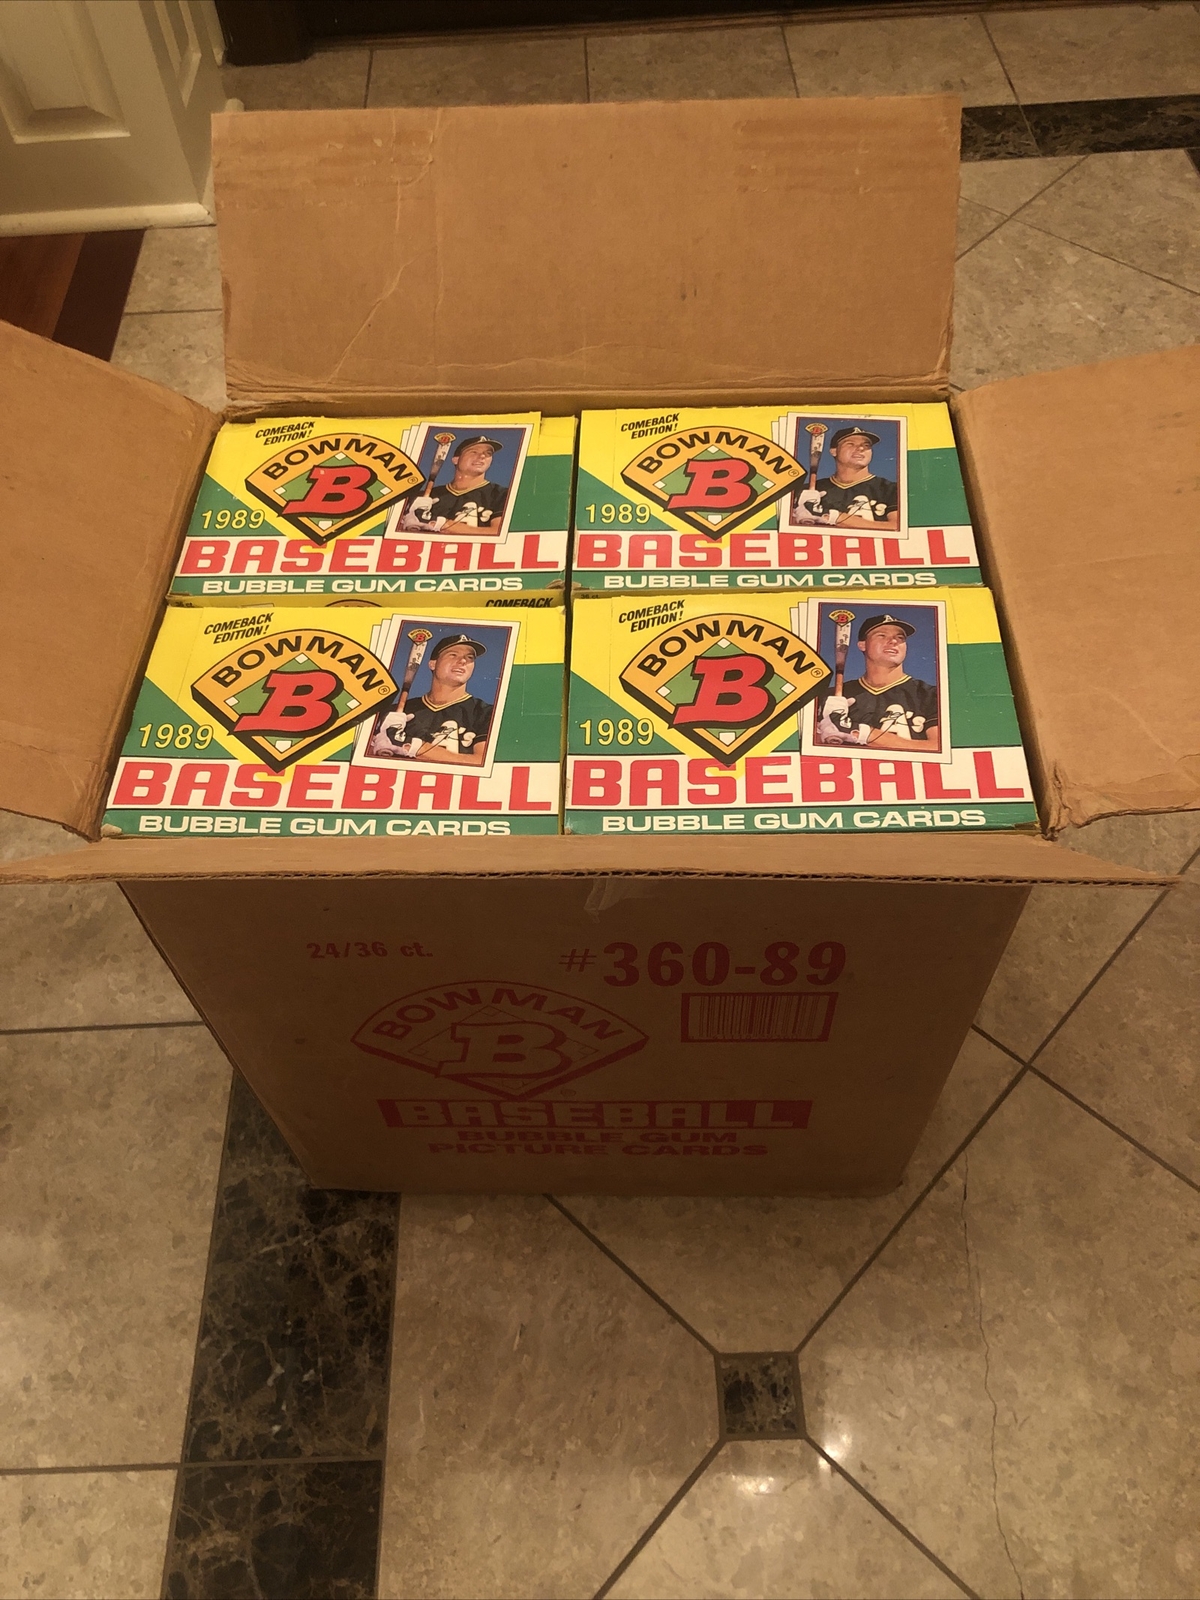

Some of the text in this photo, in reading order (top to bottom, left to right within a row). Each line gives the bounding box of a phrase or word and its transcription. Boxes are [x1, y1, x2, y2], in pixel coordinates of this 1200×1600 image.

[255, 421, 316, 438] COMEBACK
[620, 413, 680, 433] COMEBACK
[631, 422, 679, 440] EDITION!
[263, 429, 312, 446] EDITION!
[282, 464, 375, 519] B
[665, 458, 755, 511] B
[201, 509, 265, 530] 1989
[585, 504, 651, 525] 1989
[179, 533, 559, 574] BASEBALL
[576, 530, 970, 568] BASEBALL
[202, 577, 523, 594] BUBBLE GUM CARDS
[603, 573, 937, 588] BUBBLE GUM CARDS
[204, 612, 275, 635] COMEBACK
[618, 600, 685, 624] COMEBACK
[630, 610, 684, 633] EDITION!
[213, 624, 270, 644] EDITION!
[669, 653, 773, 728] B
[229, 669, 341, 737] B
[139, 723, 215, 750] 1989
[579, 719, 655, 746] 1989
[112, 760, 552, 811] BASEBALL
[572, 751, 1024, 807] BASEBALL
[138, 816, 511, 836] BUBBLE GUM CARDS
[602, 810, 986, 832] BUBBLE GUM CARDS
[306, 941, 434, 959] 24/36 ct.
[372, 988, 625, 1041] BOWMAN
[435, 1021, 573, 1078] B
[395, 1100, 796, 1128] BASEBALL
[456, 1131, 738, 1144] BUBBLE GUM
[428, 1143, 769, 1156] PICTURE CARDS
